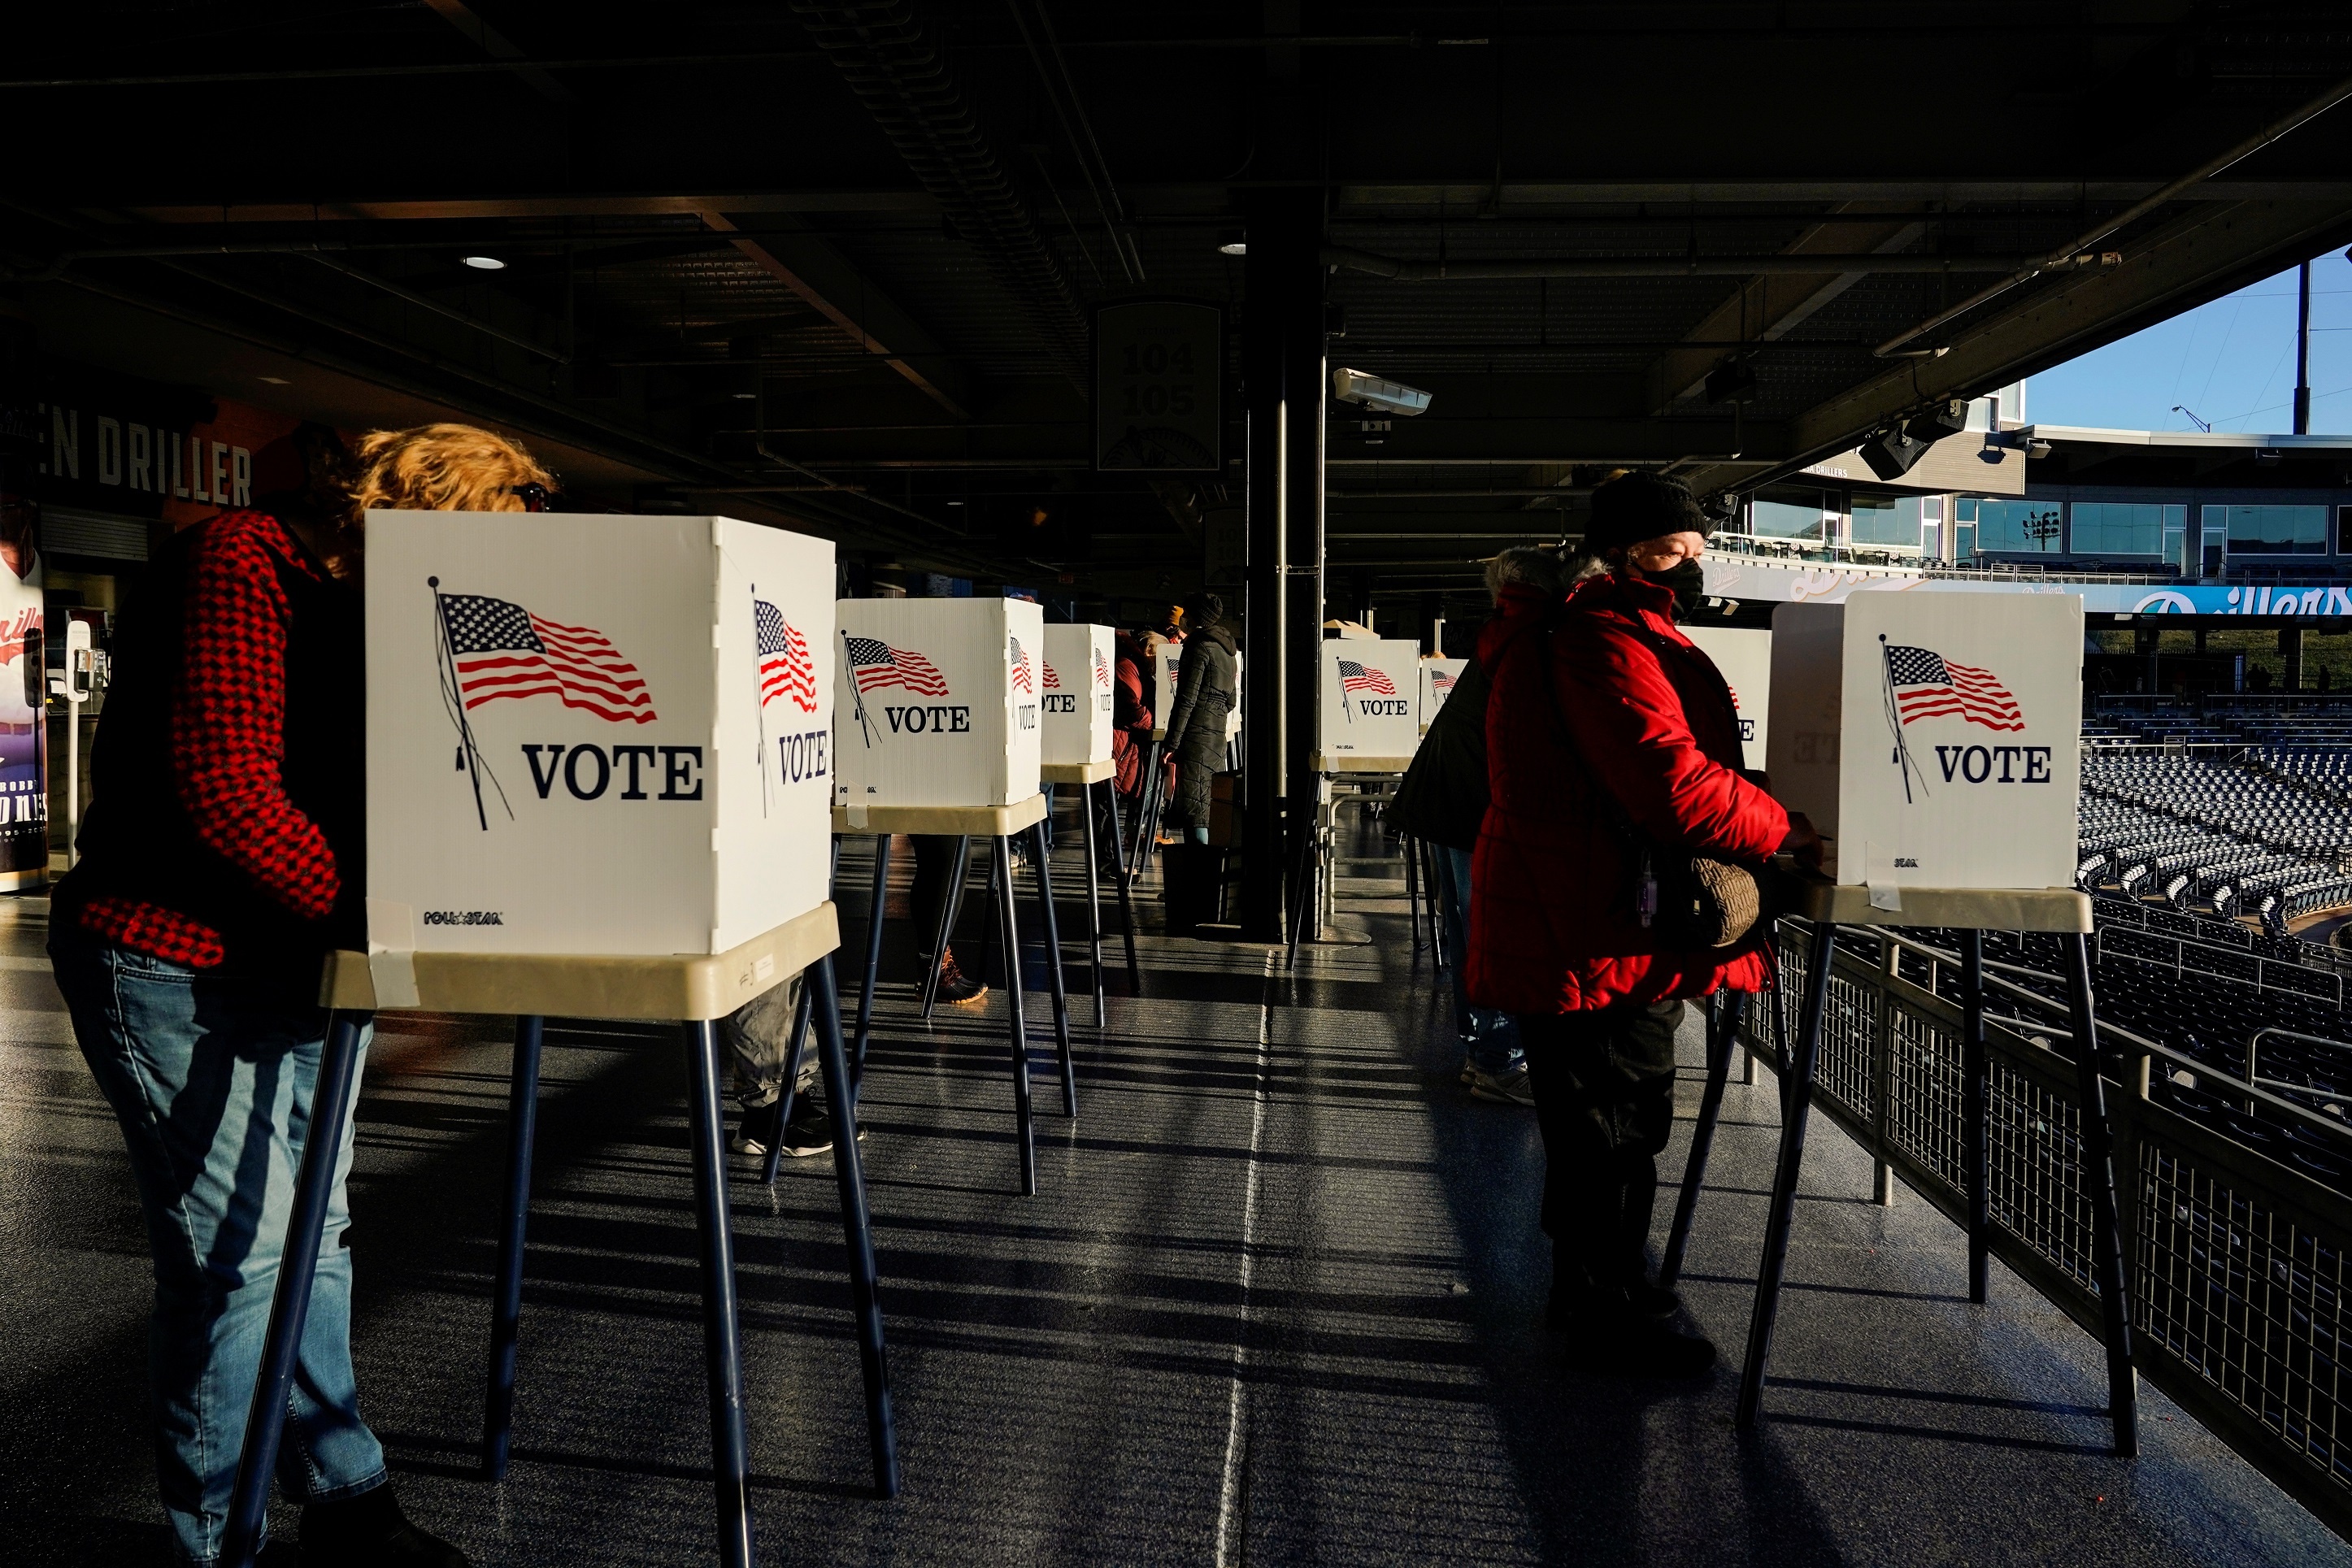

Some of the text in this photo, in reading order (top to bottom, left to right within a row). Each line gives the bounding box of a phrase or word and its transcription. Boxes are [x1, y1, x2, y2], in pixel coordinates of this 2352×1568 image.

[1123, 342, 1194, 376] 104
[1123, 384, 1195, 417] 105
[98, 415, 250, 507] DRILLER
[1815, 465, 1848, 478] DRILLERS
[1019, 705, 1035, 730] VOTE
[1041, 694, 1076, 712] TE
[1360, 700, 1407, 715] VOTE
[885, 706, 970, 733] VOTE
[522, 743, 703, 801] VOTE
[779, 730, 827, 785] VOTE
[1935, 745, 2051, 784] VOTE
[424, 911, 503, 925] POLL STAR
